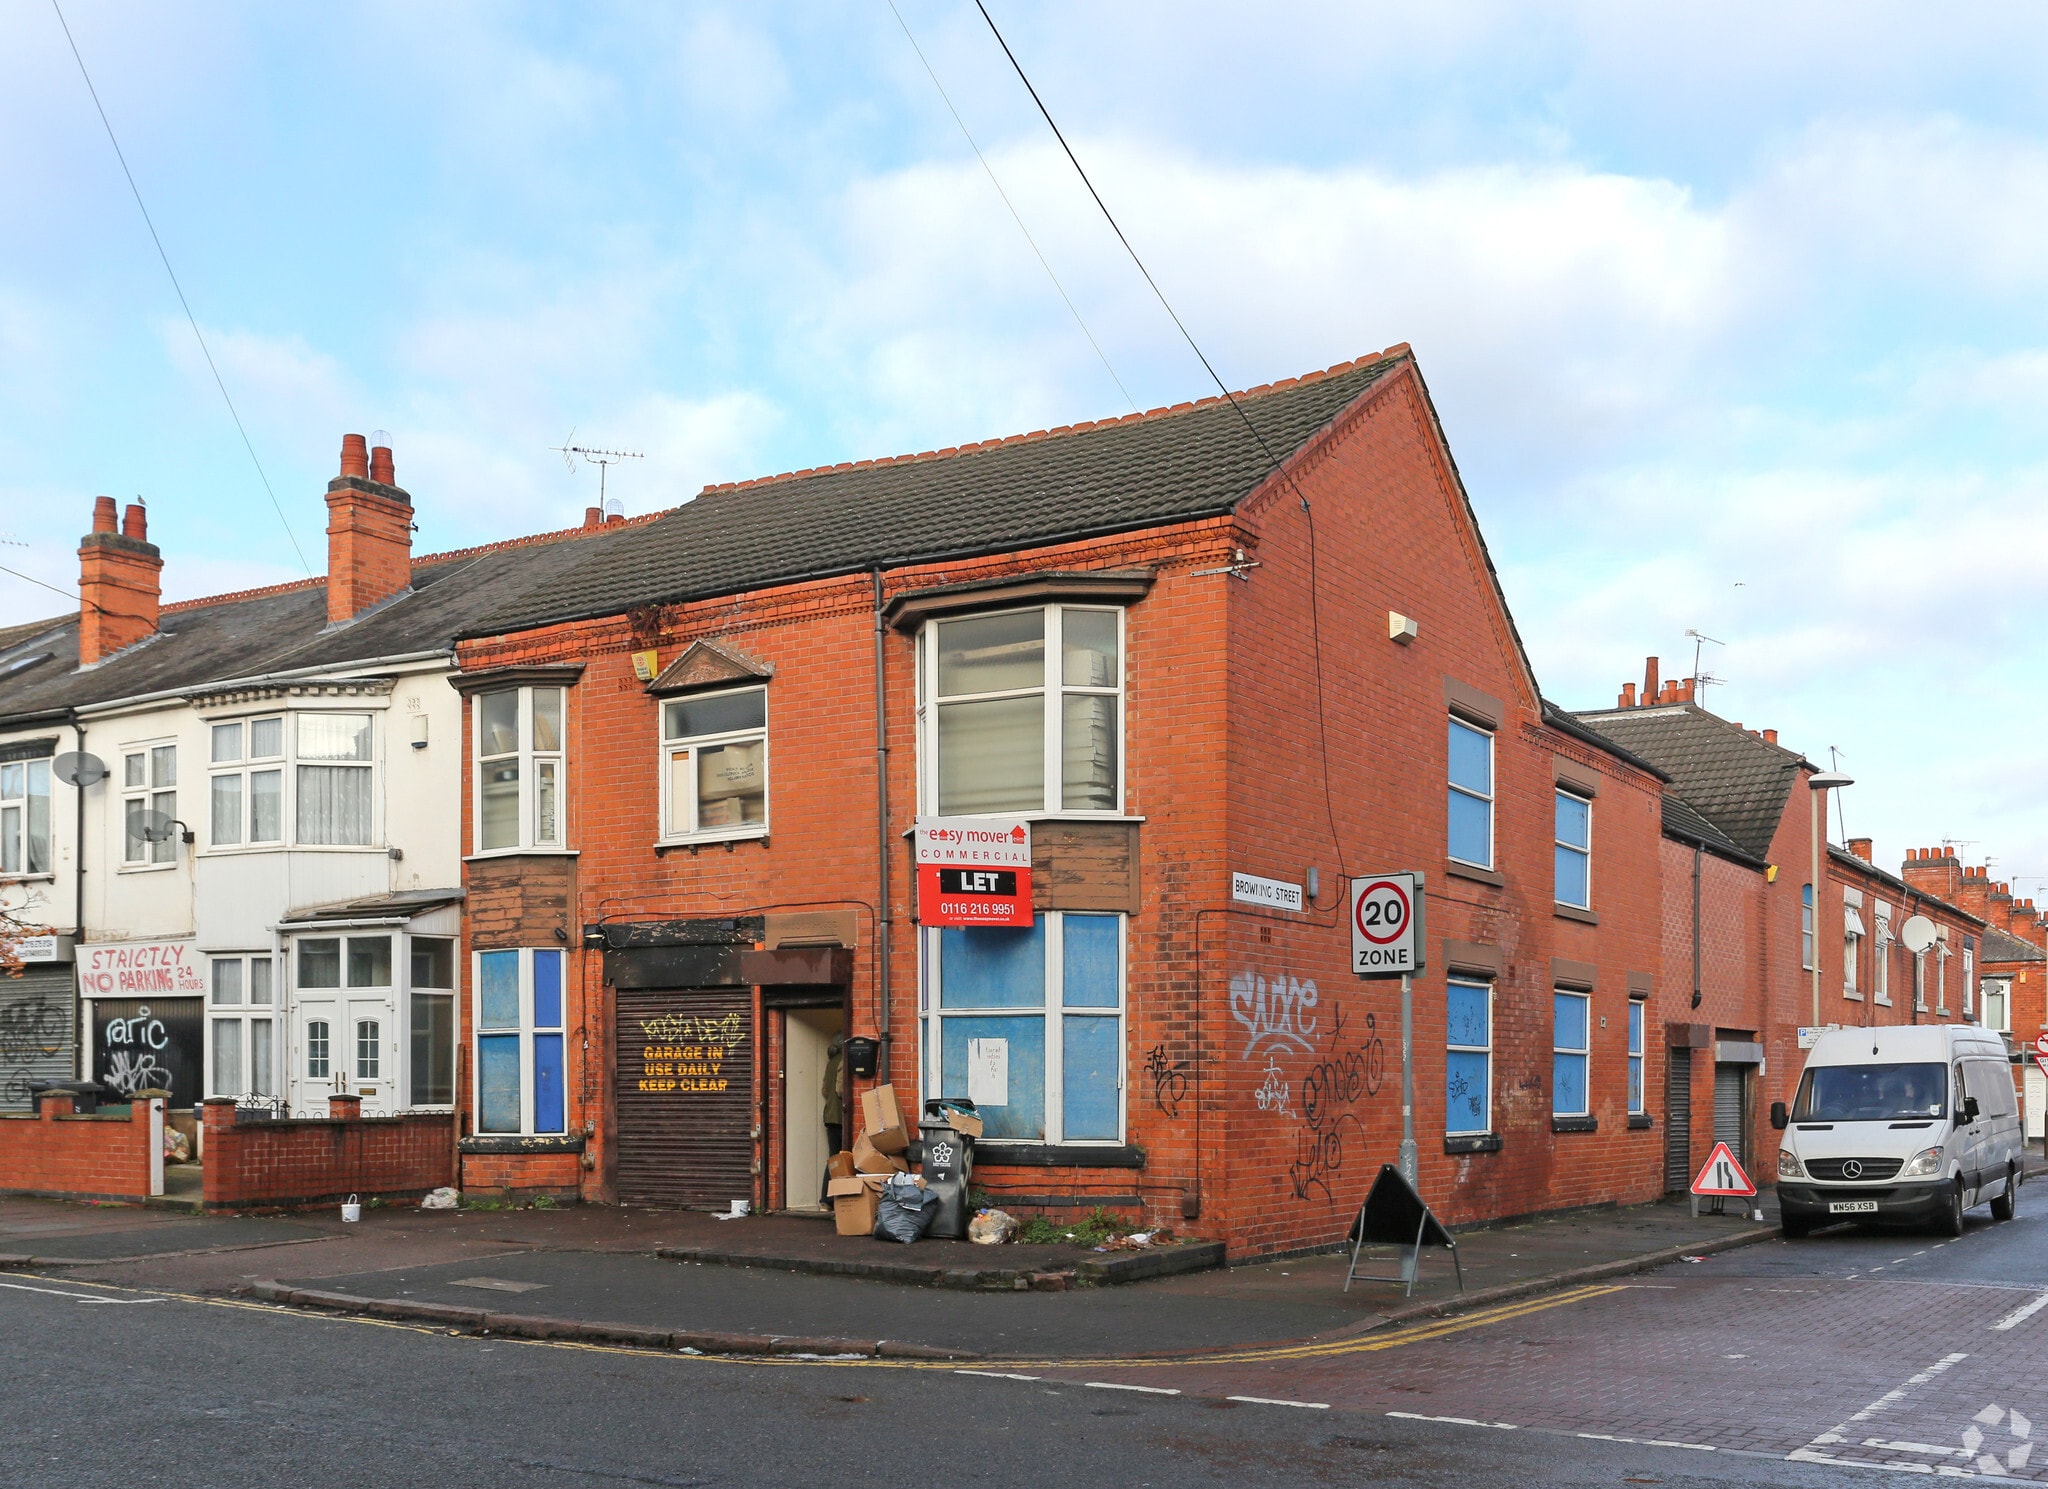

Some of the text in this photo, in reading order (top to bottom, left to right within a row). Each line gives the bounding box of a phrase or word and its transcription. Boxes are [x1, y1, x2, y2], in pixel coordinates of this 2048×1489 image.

[967, 830, 1008, 843] mover
[921, 849, 1027, 861] COMMERCIAL
[961, 871, 999, 891] LET
[1275, 887, 1300, 903] STREET
[941, 902, 1015, 915] 0116 216 9951
[1365, 900, 1402, 926] 20
[92, 945, 184, 969] STRICTLY
[1359, 948, 1408, 966] ZONE
[177, 966, 193, 978] 24
[82, 967, 174, 993] NO PARKING
[179, 979, 204, 989] HOURS
[643, 1046, 723, 1059] GARAGE IN
[644, 1063, 721, 1076] USE DAILY
[638, 1078, 728, 1092] KEEP CLEAR
[1833, 1202, 1875, 1211] WN56 XSB
